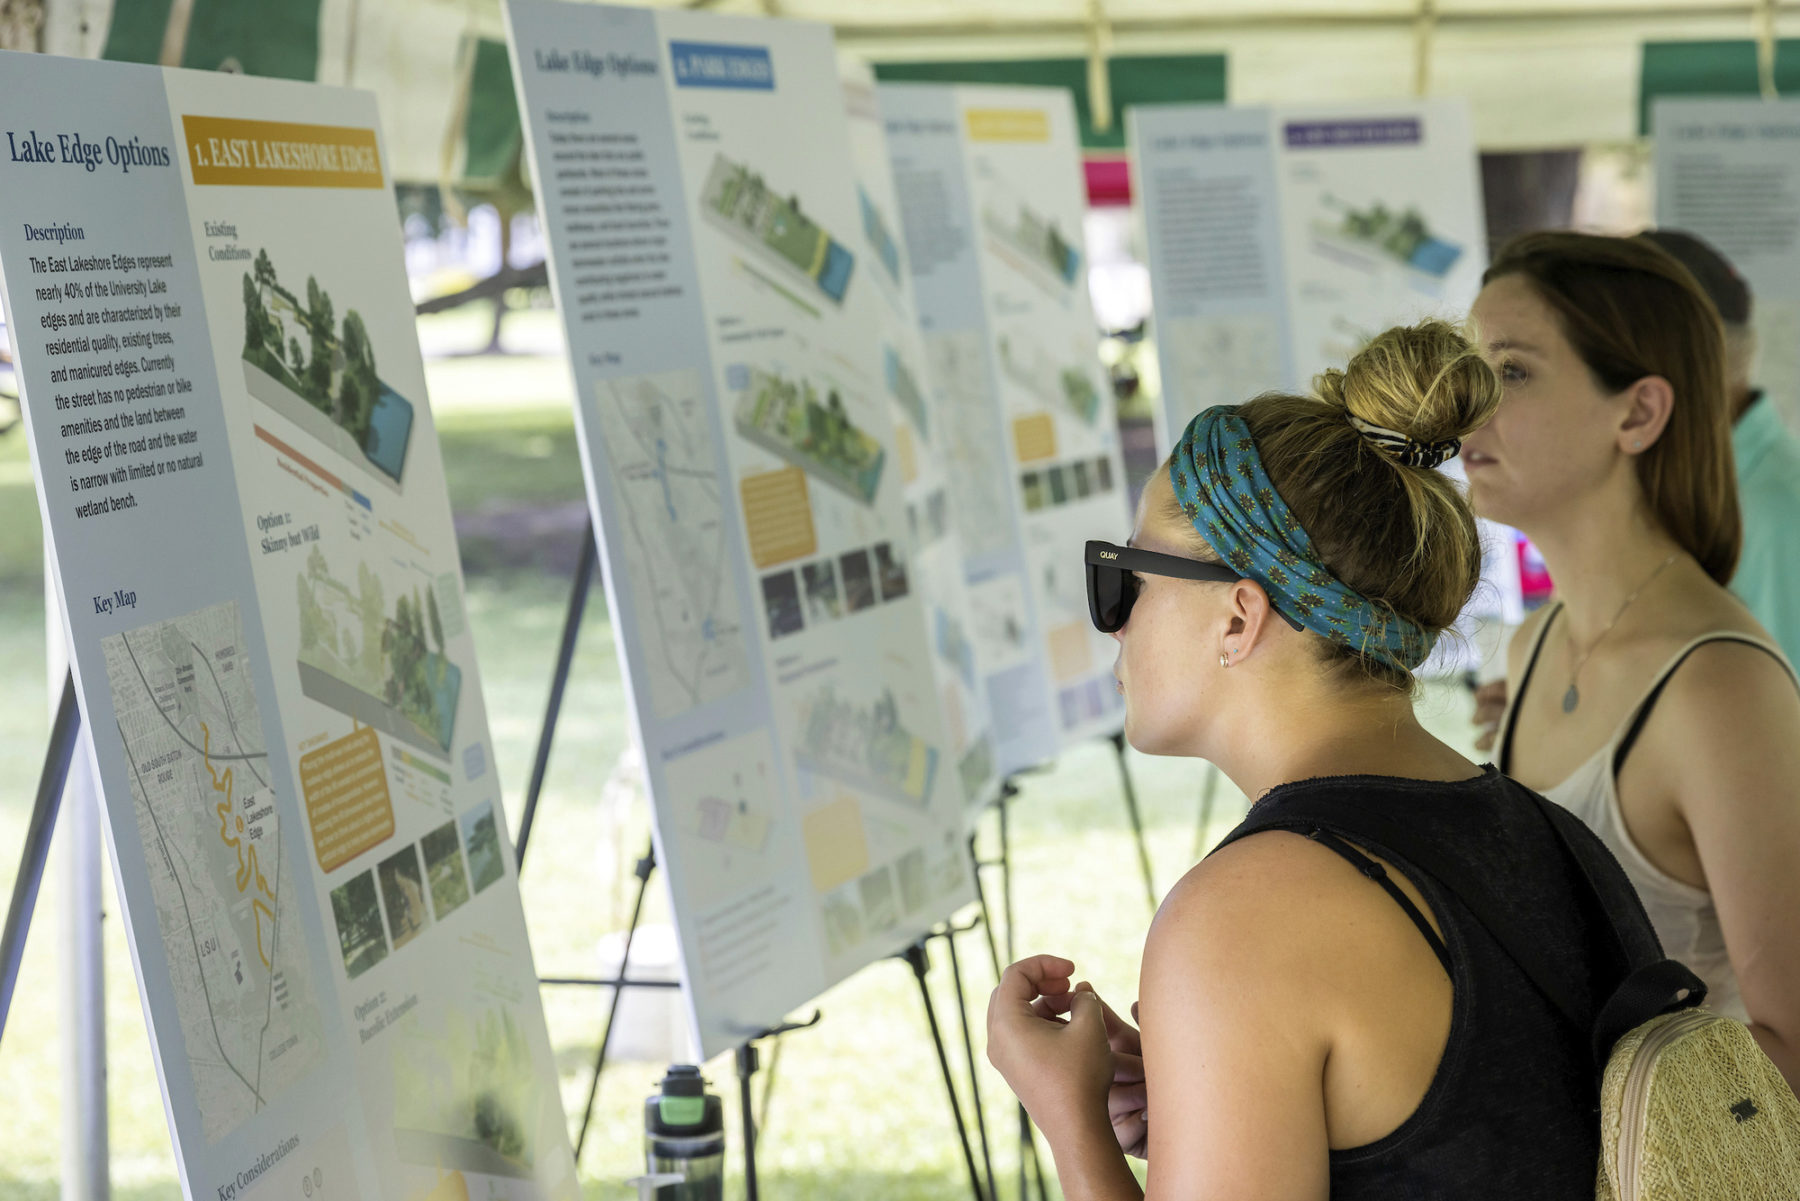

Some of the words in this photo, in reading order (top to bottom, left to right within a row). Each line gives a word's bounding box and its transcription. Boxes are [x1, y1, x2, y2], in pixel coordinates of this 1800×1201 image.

[6, 130, 56, 165] Lake
[57, 132, 103, 172] Edge
[105, 136, 170, 173] Options
[194, 143, 209, 168] 1.
[208, 137, 252, 168] EAST
[253, 138, 340, 171] LAKESHORE
[341, 145, 378, 173] EDGE
[24, 222, 85, 245] Description
[204, 221, 238, 240] Existing
[29, 257, 47, 273] The
[49, 257, 68, 273] East
[69, 255, 112, 272] Lakeshore
[112, 254, 136, 273] Edges
[137, 253, 173, 271] represent
[208, 246, 252, 262] Conditions
[35, 284, 62, 303] nearly
[64, 282, 83, 299] 40%
[85, 282, 94, 298] of
[94, 282, 109, 298] the
[109, 279, 147, 298] University
[148, 279, 167, 294] Lake
[40, 314, 67, 331] edges
[69, 309, 85, 327] and
[86, 311, 100, 325] are
[101, 304, 153, 323] characterized
[153, 304, 163, 323] by
[164, 303, 182, 318] their
[45, 334, 91, 356] residential
[122, 331, 152, 349] existing
[152, 330, 174, 346] trees,
[51, 365, 68, 383] and
[69, 363, 114, 381] manicured
[114, 360, 140, 378] edges.
[140, 354, 175, 373] Currently
[55, 394, 71, 410] the
[71, 393, 96, 409] street
[97, 388, 113, 405] has
[113, 389, 125, 402] no
[126, 381, 166, 404] pedestrian
[167, 383, 175, 395] or
[176, 378, 193, 393] bike
[60, 418, 103, 438] amenities
[103, 414, 120, 431] and
[121, 411, 134, 428] the
[134, 409, 153, 426] land
[153, 406, 185, 423] between
[65, 449, 81, 465] the
[82, 446, 103, 464] edge
[103, 441, 113, 458] of
[113, 440, 128, 456] the
[128, 437, 147, 453] road
[148, 434, 163, 450] and
[163, 432, 176, 447] the
[177, 429, 198, 445] water
[69, 475, 79, 492] is
[80, 473, 109, 490] narrow
[109, 467, 128, 485] with
[128, 460, 156, 481] limited
[157, 463, 166, 476] or
[166, 459, 177, 473] no
[177, 452, 203, 471] natural
[75, 496, 109, 519] wetland
[110, 492, 138, 512] bench.
[257, 512, 284, 534] Option
[261, 536, 288, 555] Skinny
[288, 531, 301, 547] but
[301, 524, 320, 543] Wild
[1100, 551, 1118, 560] QUAY
[93, 595, 113, 615] Key
[114, 588, 137, 609] Map
[243, 796, 256, 809] East
[246, 805, 274, 825] Lakeshore
[249, 826, 264, 841] Edge
[200, 937, 216, 957] LSU
[217, 1182, 236, 1201] Key
[236, 1133, 300, 1190] Considerations
